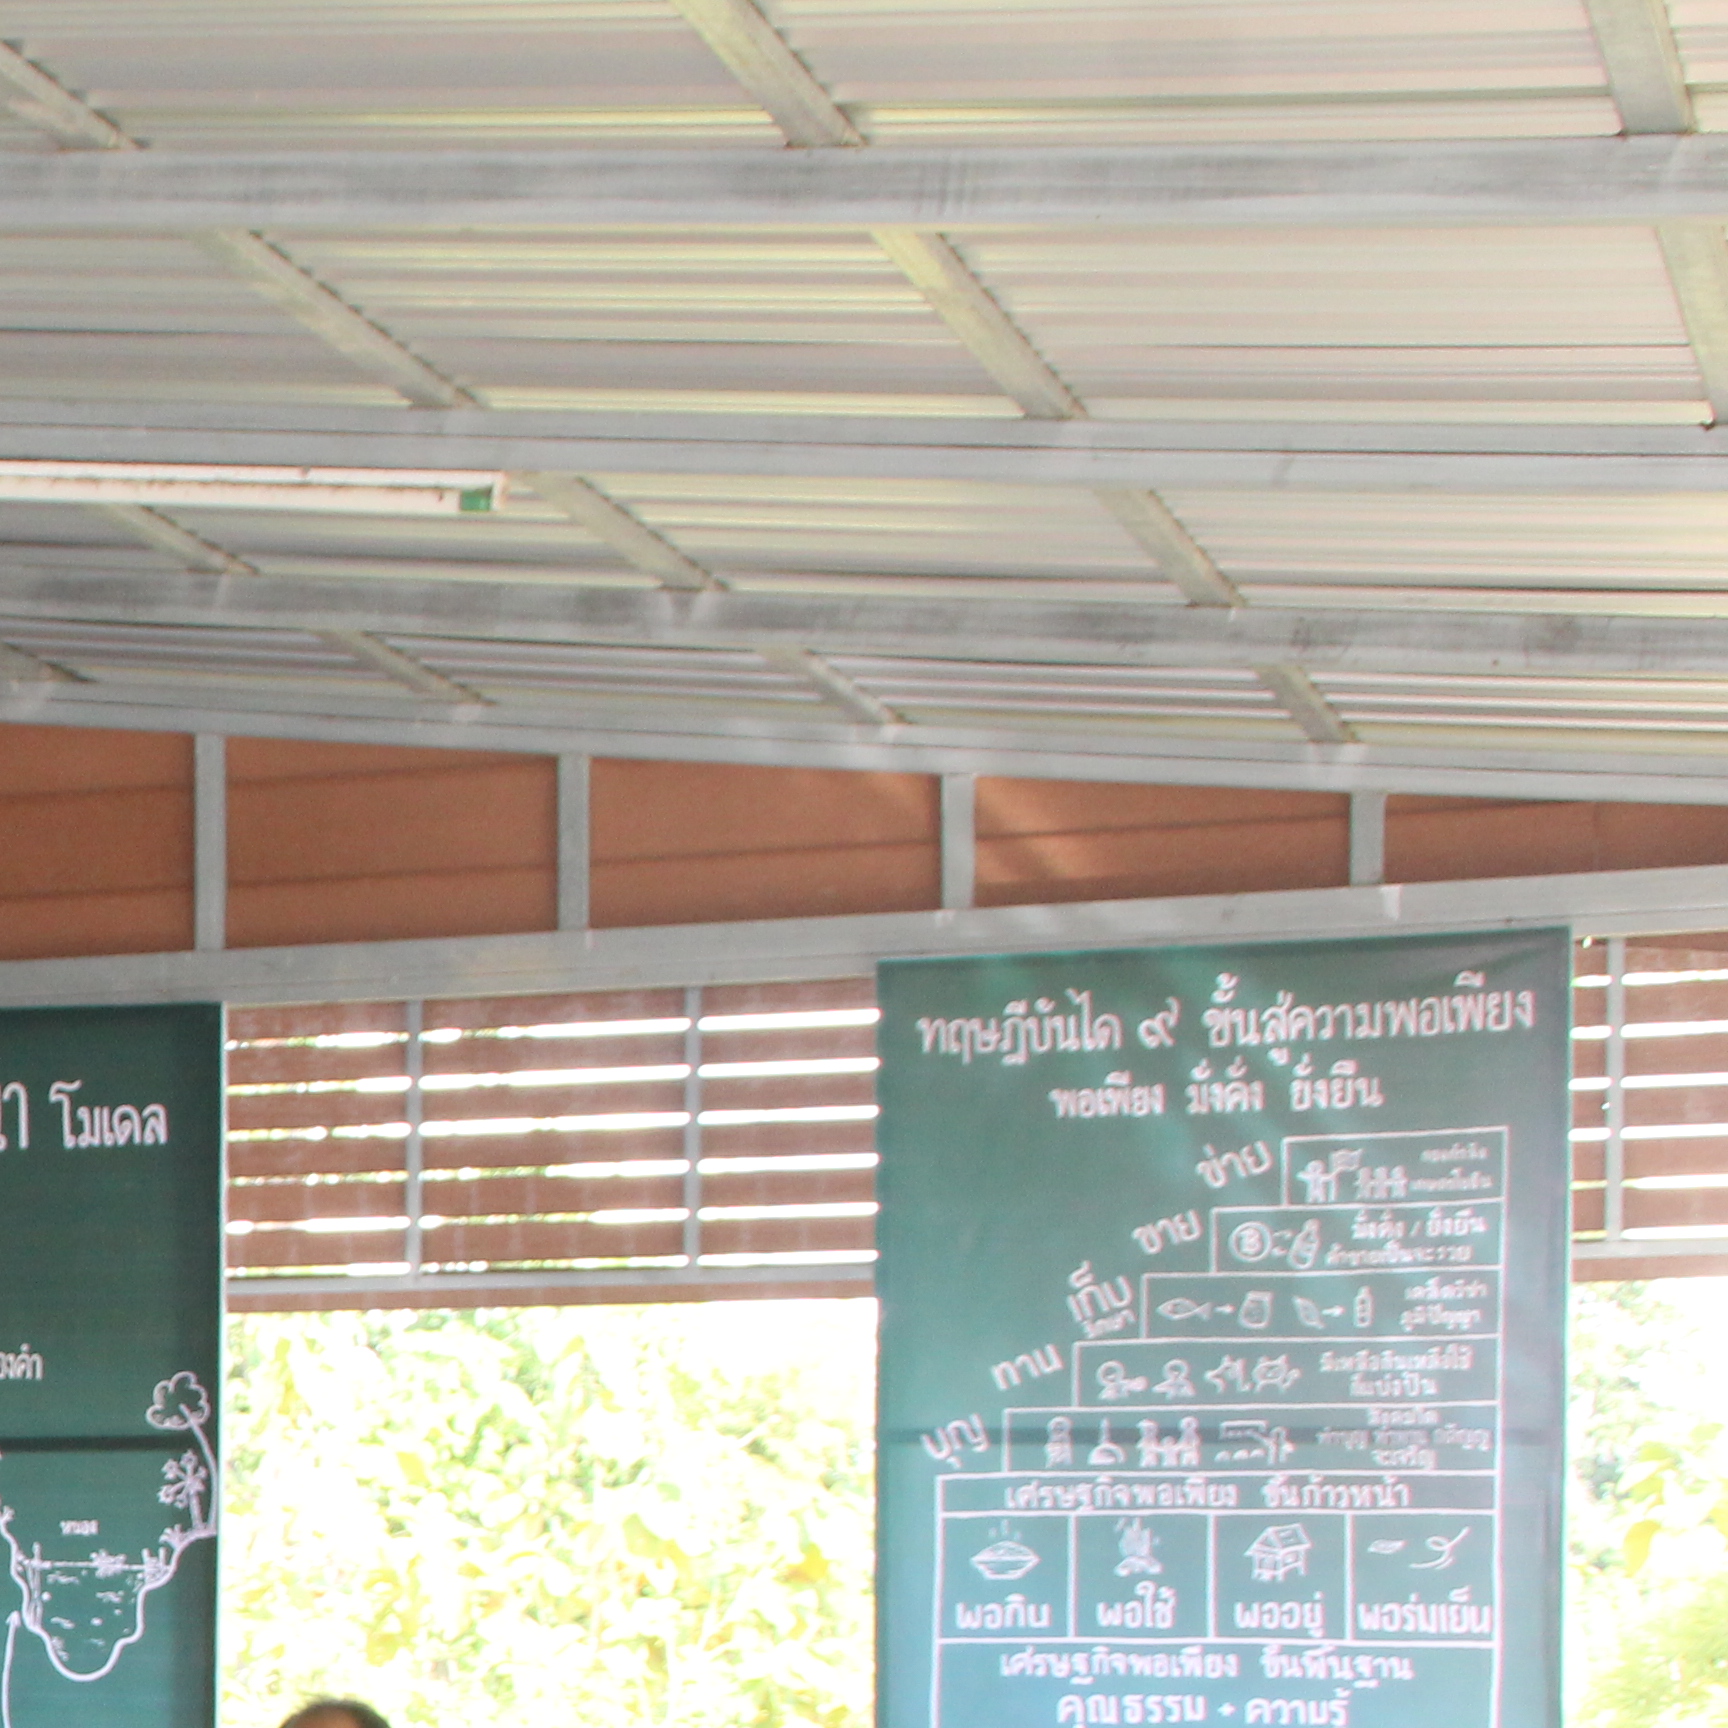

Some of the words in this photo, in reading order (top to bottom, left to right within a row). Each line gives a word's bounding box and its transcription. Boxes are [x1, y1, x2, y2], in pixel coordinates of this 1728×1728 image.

[1049, 1070, 1166, 1118] พอเพียง
[1186, 1056, 1265, 1116] มั่งคั่ง
[1290, 1054, 1385, 1112] ยั่งยืน
[49, 1080, 170, 1150] โมเดล
[1196, 1140, 1275, 1189] ข่าย
[1131, 1209, 1203, 1255] ขาย
[1067, 1259, 1134, 1323] เก็บ
[991, 1344, 1065, 1391] ทาน
[920, 1413, 991, 1470] บุญ
[1096, 1582, 1175, 1629] พอใช้
